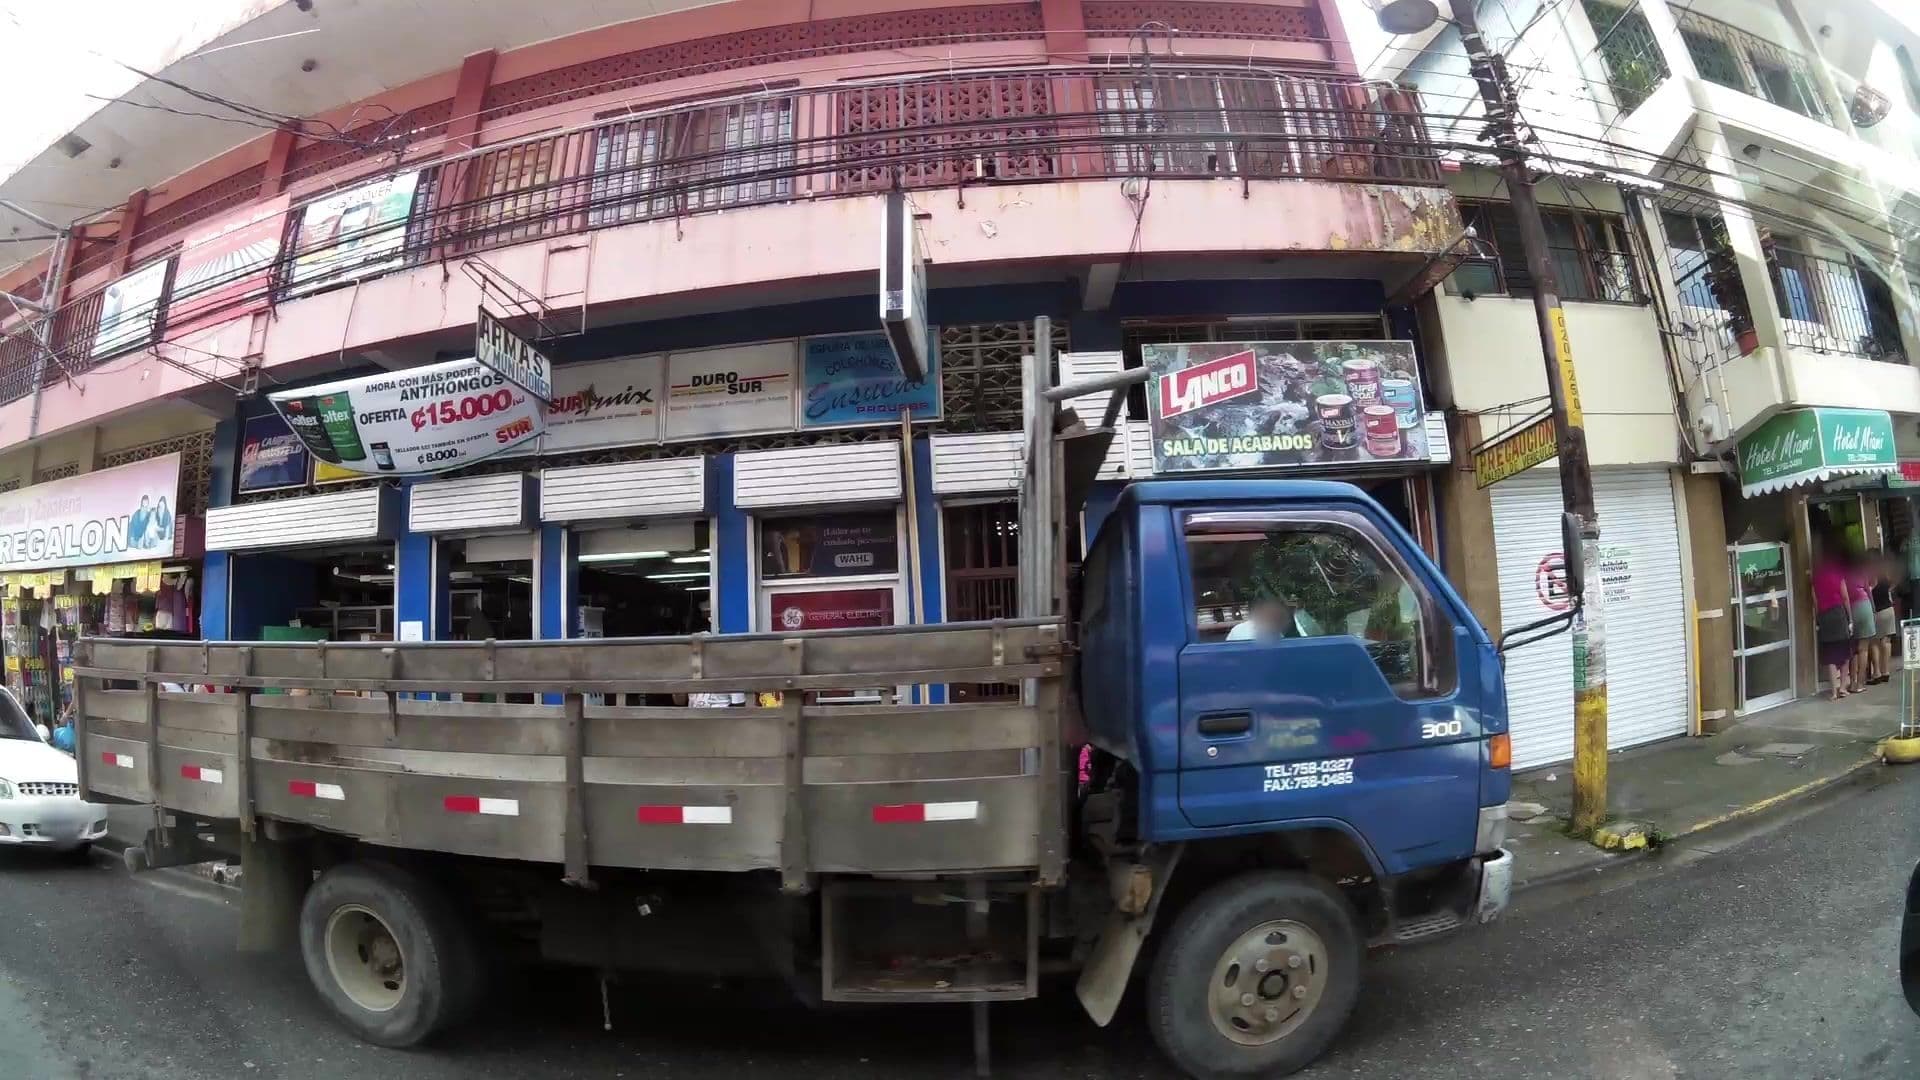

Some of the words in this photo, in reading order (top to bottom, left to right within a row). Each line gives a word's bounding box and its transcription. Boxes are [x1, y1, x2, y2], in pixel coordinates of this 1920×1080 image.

[479, 314, 544, 378] ARMAS
[365, 381, 396, 393] AHORA
[399, 376, 419, 388] CON
[446, 367, 480, 380] PODER
[400, 373, 504, 402] ANTIHONGOS
[691, 371, 738, 388] DURO
[728, 380, 763, 395] SUR
[1168, 363, 1247, 412] LANCO
[322, 410, 350, 423] oltex
[360, 407, 407, 426] OFERTA
[495, 418, 534, 444] SUR
[1833, 424, 1860, 451] Hotel
[1860, 425, 1885, 451] Miami
[1163, 437, 1204, 458] SALA
[1207, 437, 1230, 454] DE
[1231, 433, 1313, 452] ACABADOS
[1480, 419, 1555, 475] PRECAUCION
[1745, 436, 1779, 471] Hotel
[1780, 428, 1816, 462] Miami
[840, 553, 870, 564] WAHL
[808, 610, 845, 621] GENERAL
[1421, 720, 1462, 739] 300
[1264, 758, 1354, 777] TEL:758-0327
